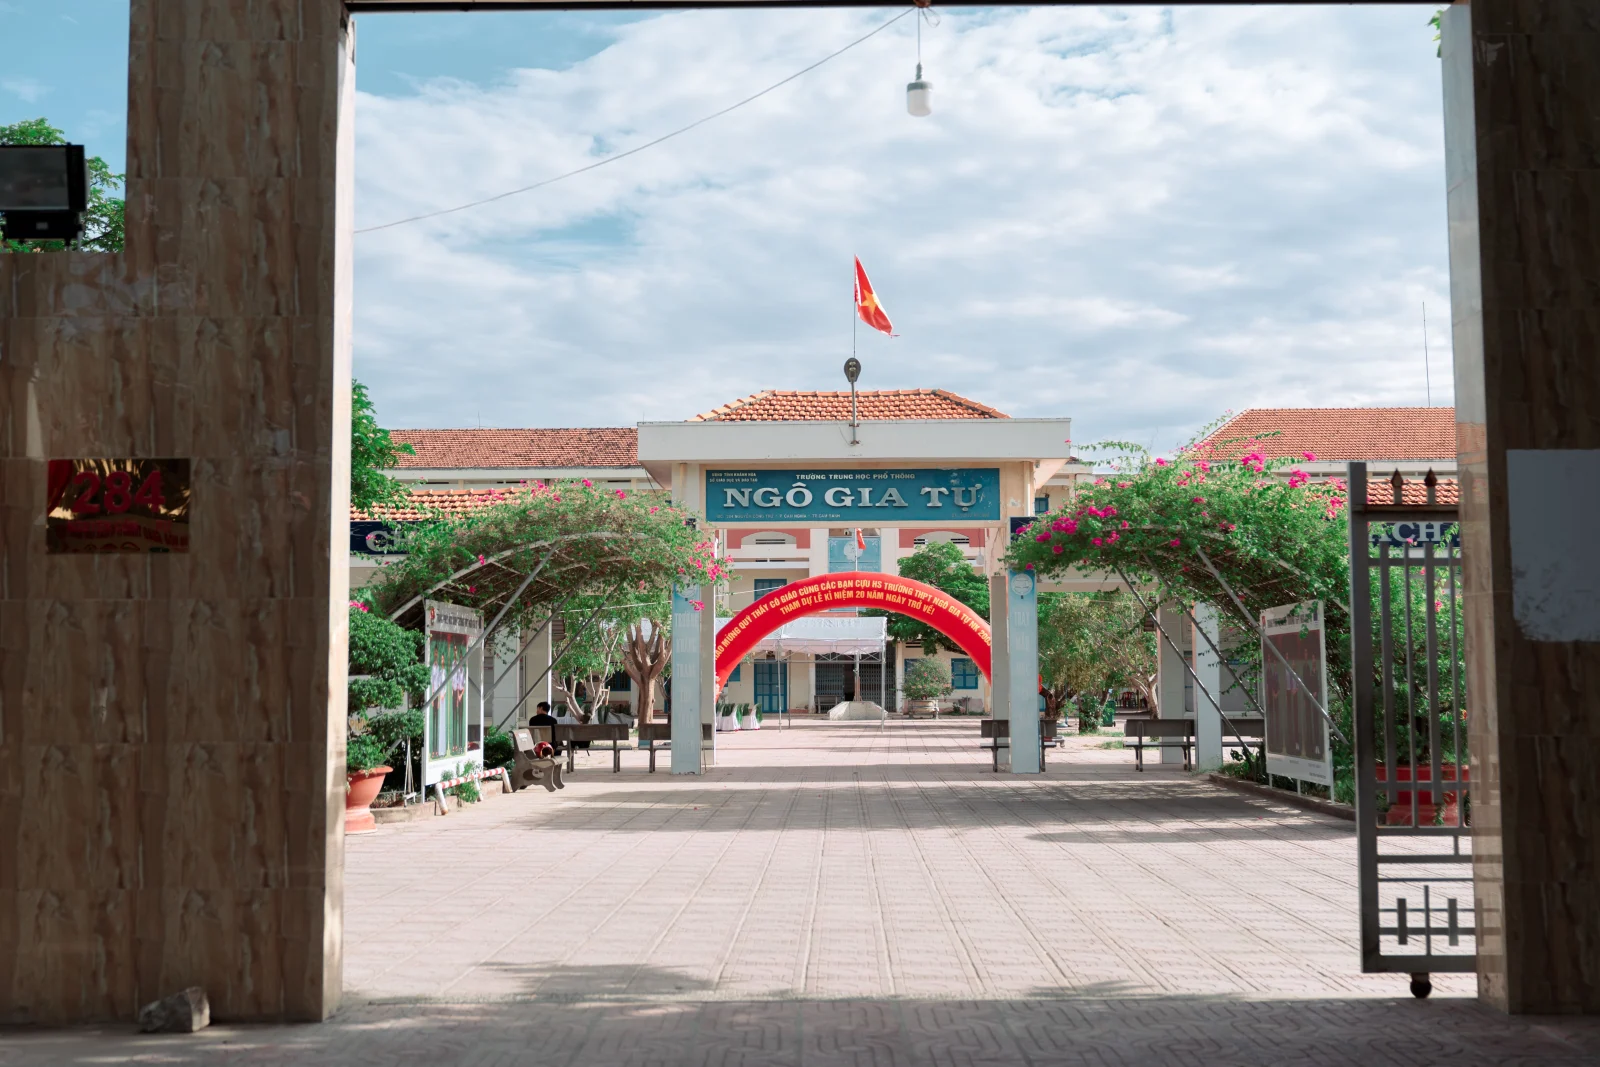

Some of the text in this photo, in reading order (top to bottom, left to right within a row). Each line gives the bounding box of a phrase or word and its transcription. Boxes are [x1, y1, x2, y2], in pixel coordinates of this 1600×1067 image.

[873, 471, 888, 480] PHỔ
[72, 470, 166, 514] 284
[723, 482, 982, 512] NGÔ GIA TỰ
[721, 628, 742, 648] MỪNG
[769, 597, 780, 609] CÔ
[780, 590, 798, 604] GIÁO
[798, 585, 819, 596] CÙNG
[820, 581, 836, 590] CÁC
[837, 580, 854, 590] BẠN
[855, 578, 870, 589] CỰU
[872, 580, 882, 589] HS
[884, 582, 914, 595] TRƯỜNG
[914, 590, 932, 602] THPT
[933, 596, 949, 610] NGÔ
[948, 605, 960, 617] GIA
[960, 613, 972, 625] TỰ
[969, 620, 981, 632] NK
[780, 600, 801, 615] THAM
[801, 596, 812, 607] DỰ
[814, 592, 823, 603] LỄ
[834, 590, 854, 600] NIỆM
[855, 590, 865, 598] 20
[866, 590, 884, 599] NĂM
[885, 593, 907, 604] NGÀY
[908, 600, 922, 610] TRỞ
